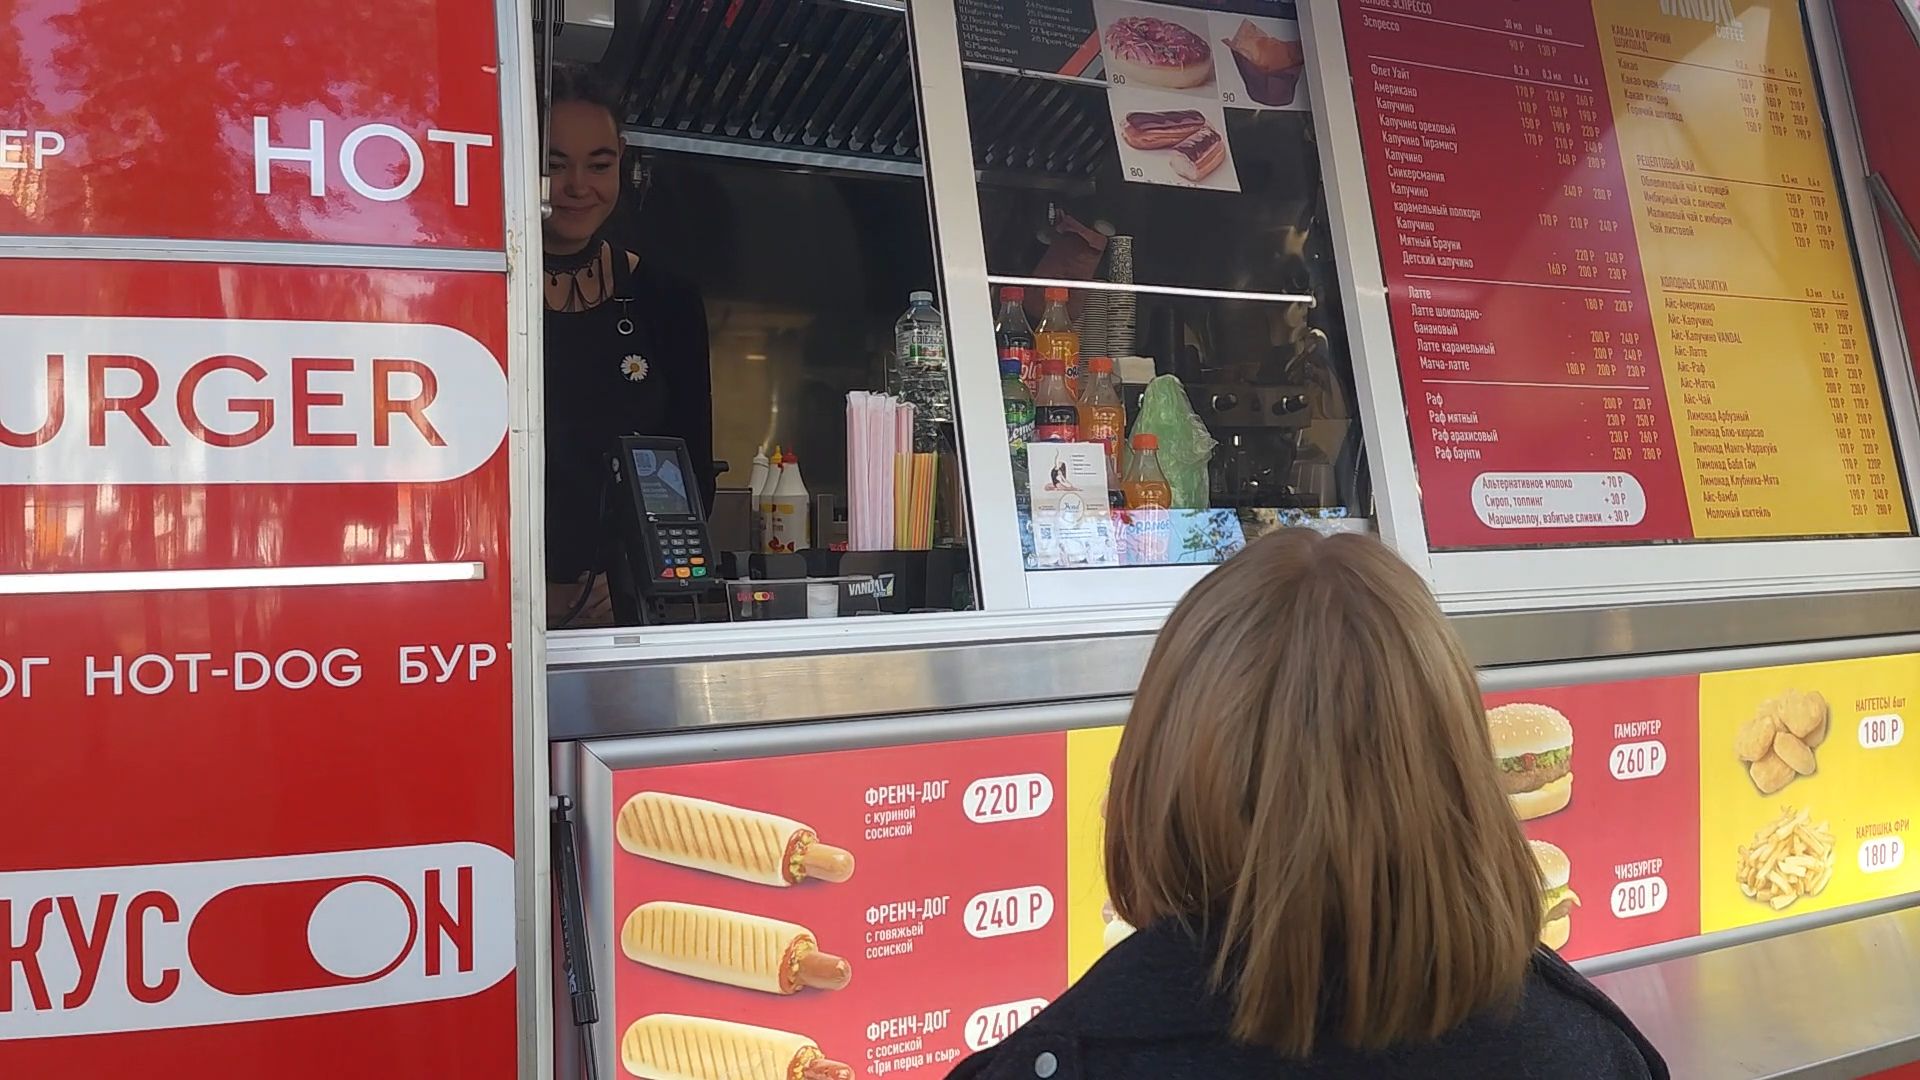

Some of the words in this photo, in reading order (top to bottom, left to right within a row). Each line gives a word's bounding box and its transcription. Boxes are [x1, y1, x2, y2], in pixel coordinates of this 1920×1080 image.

[1363, 14, 1400, 32] Эспрессо
[1112, 73, 1126, 86] 80
[1370, 63, 1391, 77] Флет
[1392, 66, 1410, 80] Уайт
[1374, 80, 1417, 97] Американо
[1222, 92, 1236, 103] 90
[1376, 96, 1415, 114] Капучино
[1379, 113, 1418, 130] Капучино
[1418, 121, 1457, 135] ореховый
[1382, 131, 1420, 147] Капучино
[1421, 136, 1458, 154] Тирамису
[252, 116, 494, 207] HOT
[1384, 148, 1423, 164] Капучино
[1129, 167, 1144, 179] 80
[1388, 164, 1446, 182] Сникерсмания
[1390, 182, 1429, 198] Капучино
[1394, 202, 1448, 216] карамельный
[1449, 207, 1482, 221] попкорн
[1396, 216, 1434, 232] Капучино
[1399, 233, 1432, 249] Мятный
[1432, 236, 1462, 252] Брауни
[1402, 251, 1436, 266] Детский
[1437, 256, 1474, 270] капучино
[1408, 286, 1432, 299] Латте
[1411, 303, 1434, 316] Латте
[1435, 308, 1482, 320] шоколадно-
[1664, 298, 1716, 312] Айс-Американо
[1414, 321, 1458, 336] банановый
[1668, 313, 1714, 328] Айс-Капучино
[1717, 332, 1742, 344] VANDAL
[1417, 338, 1440, 352] Латте
[1441, 342, 1496, 356] карамельный
[1674, 345, 1708, 358] Айс-Латте
[1420, 356, 1470, 370] Матча-латте
[1678, 362, 1706, 376] Айс-Раф
[1680, 378, 1716, 389] Айс-Матча
[1426, 392, 1444, 408] Раф
[1684, 393, 1712, 405] Айс-Чай
[1429, 410, 1446, 426] Раф
[1448, 412, 1478, 424] мятный
[1687, 410, 1716, 422] Лимонад
[1718, 410, 1750, 424] Арбузный
[1432, 428, 1450, 444] Раф
[1450, 430, 1498, 445] арахисовый
[1690, 426, 1720, 438] Лимонад
[1434, 446, 1452, 462] Раф
[1453, 446, 1481, 462] баунти
[1694, 442, 1724, 454] Лимонад
[1697, 458, 1726, 470] Лимонад
[1482, 477, 1544, 490] Альтернативное
[1544, 478, 1572, 489] молоко
[1700, 474, 1730, 487] Лимонад
[1730, 474, 1779, 488] Клубника-Мята
[1484, 494, 1512, 508] Сироп,
[1513, 496, 1543, 506] топпинг
[1488, 512, 1542, 526] Маршмеллоу,
[1544, 512, 1574, 524] взбитые
[1576, 513, 1602, 523] сливки
[1706, 507, 1740, 519] Молочный
[1742, 506, 1771, 518] коктейль
[848, 579, 886, 596] VANDAL
[86, 647, 363, 697] HOT-DOG
[399, 642, 513, 685] БУР
[1855, 698, 1891, 713] НАГГЕТСЫ
[1892, 696, 1906, 710] 6шт
[1614, 719, 1662, 739] ГАМБУРГЕР
[1864, 720, 1886, 744] 180
[1616, 748, 1645, 774] 260
[864, 780, 950, 807] ФРЕНЧ-ДОГ
[974, 782, 1018, 817] 220
[864, 814, 872, 825] с
[874, 805, 916, 825] куриной
[864, 823, 912, 841] сосиской
[1856, 823, 1892, 840] КАРТОШКА
[1894, 818, 1910, 834] ФРИ
[1864, 844, 1886, 868] 180
[1614, 858, 1662, 880] ЧИЗБУРГЕР
[1618, 886, 1646, 913] 280
[866, 896, 950, 926] ФРЕНЧ-ДОГ
[975, 896, 1018, 932] 240
[866, 933, 872, 944] с
[874, 924, 924, 943] говяжьей
[866, 940, 913, 960] сосиской
[866, 1009, 951, 1042] ФРЕНЧ-ДОГ
[976, 1009, 1019, 1047] 240
[866, 1048, 873, 1060] с
[874, 1037, 922, 1059] сосиской
[866, 1058, 892, 1077] «Три
[894, 1052, 924, 1073] перца
[926, 1052, 933, 1066] и
[935, 1046, 961, 1069] сыр»
